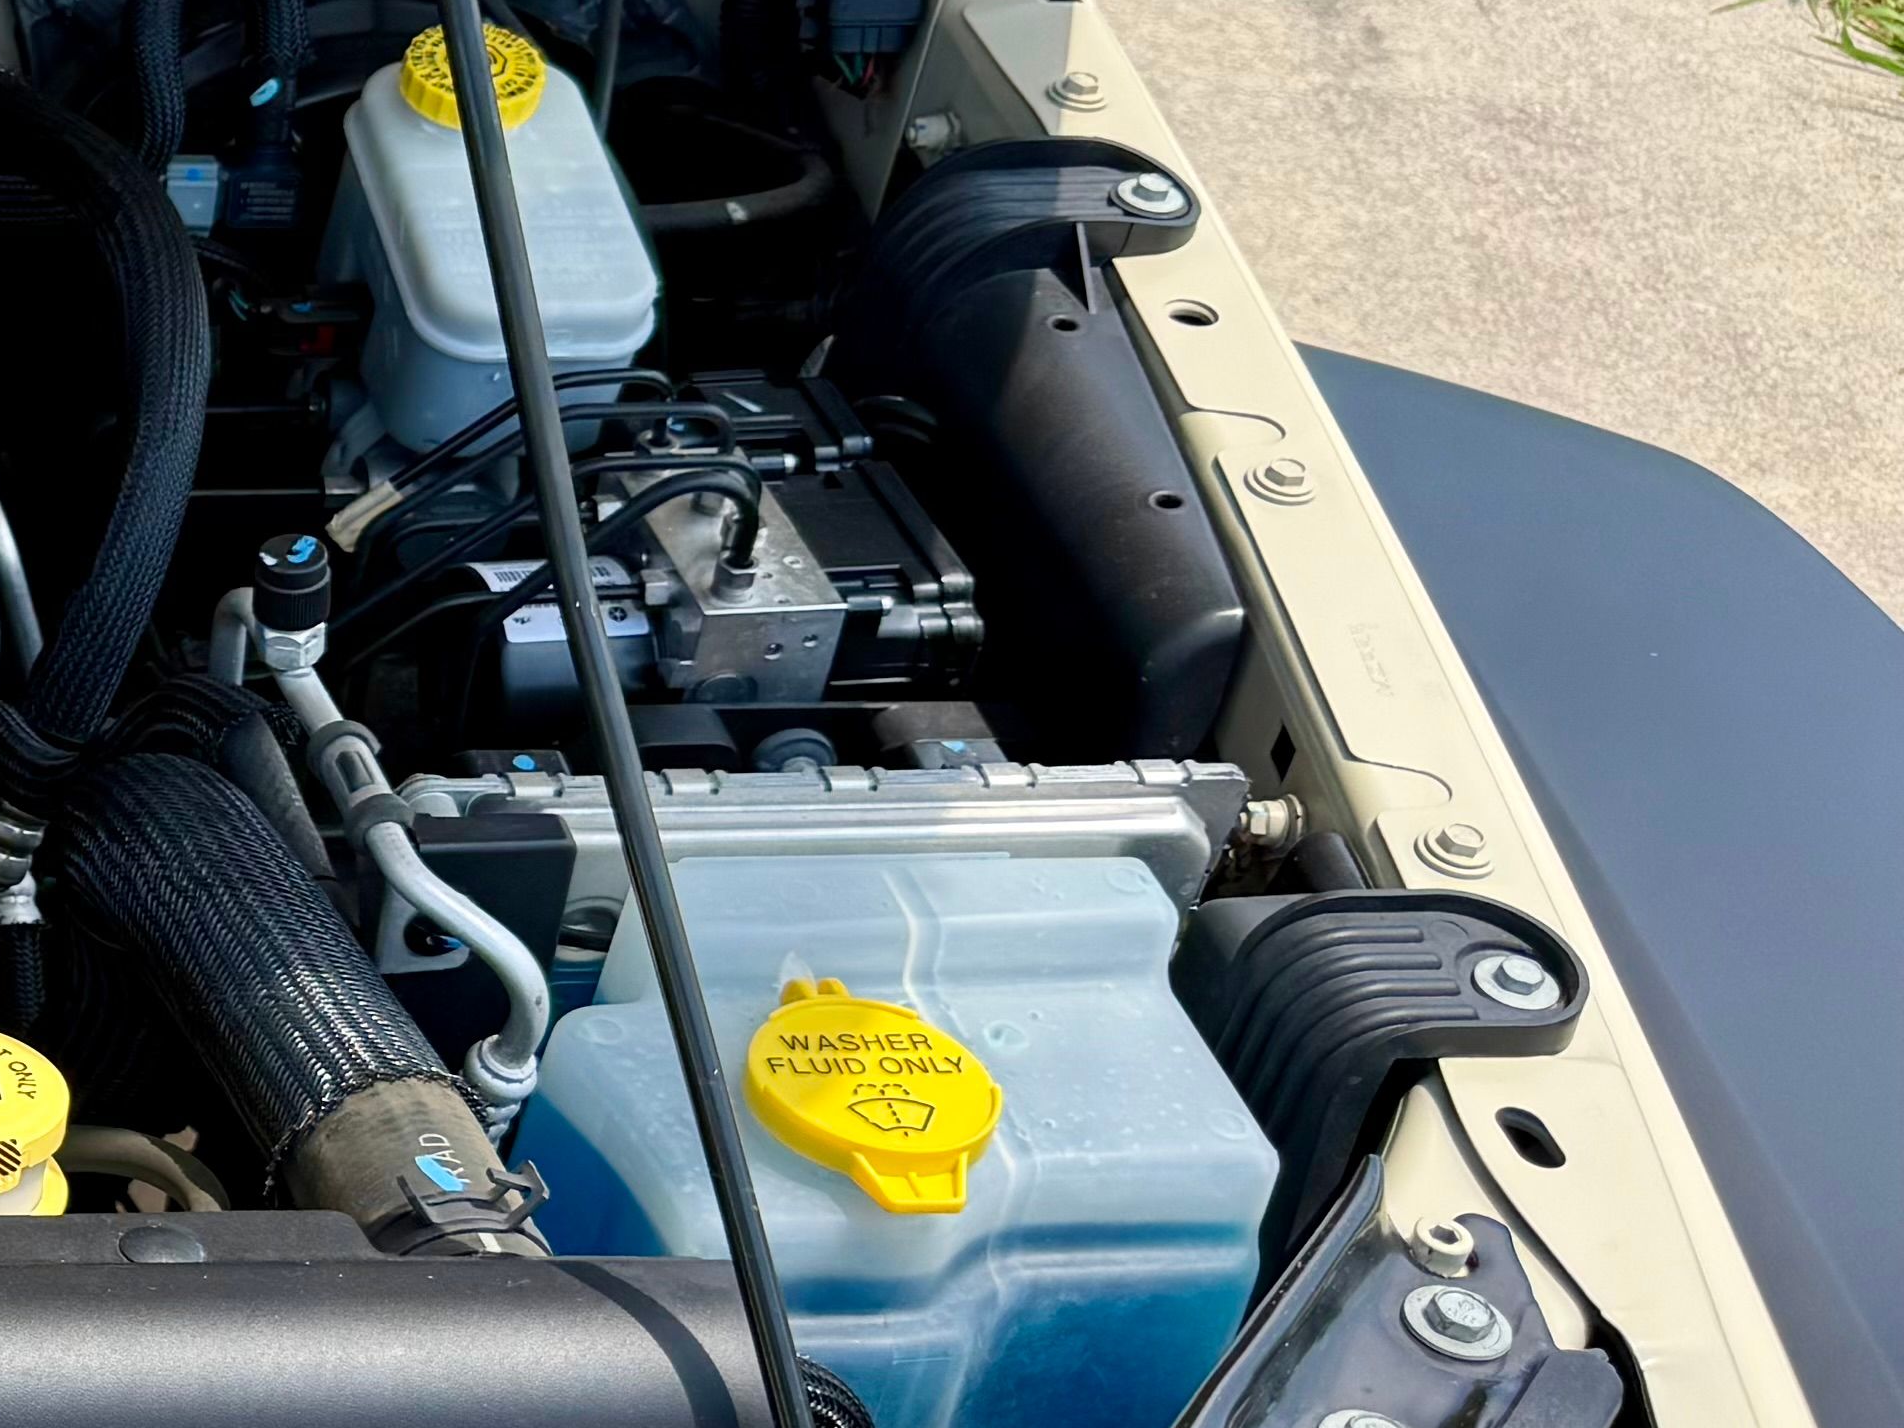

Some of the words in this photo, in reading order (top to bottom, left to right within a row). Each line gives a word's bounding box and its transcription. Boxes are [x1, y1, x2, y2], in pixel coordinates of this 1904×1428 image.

[779, 1033, 934, 1052] WASHER
[765, 1056, 867, 1075] FLUID
[878, 1056, 964, 1075] ONLY
[8, 1061, 37, 1100] ONLY
